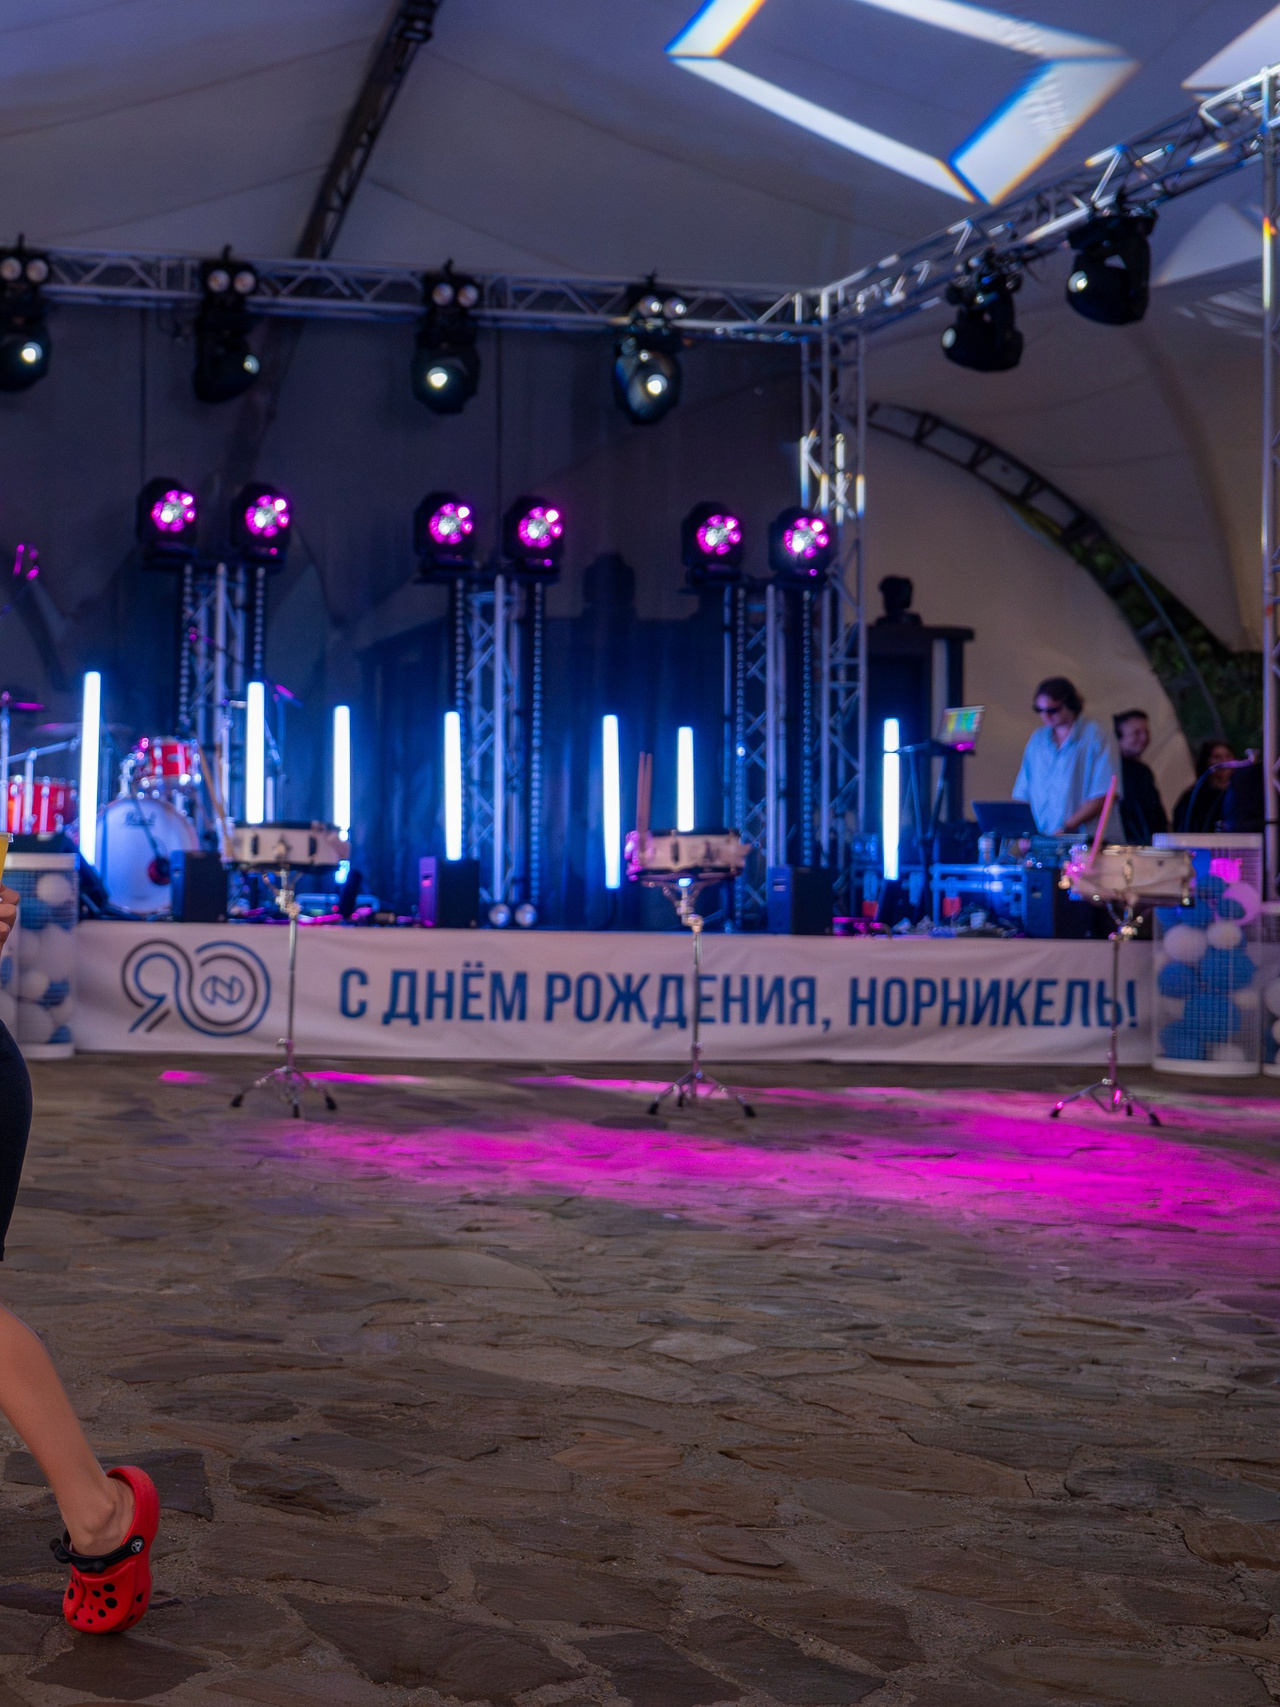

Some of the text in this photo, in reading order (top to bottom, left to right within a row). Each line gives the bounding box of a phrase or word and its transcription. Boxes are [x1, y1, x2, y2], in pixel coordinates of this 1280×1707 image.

[339, 961, 1139, 1030] С ДНЁМ РОЖДЕНИЯ, НОРНИКЕЛЬ!
